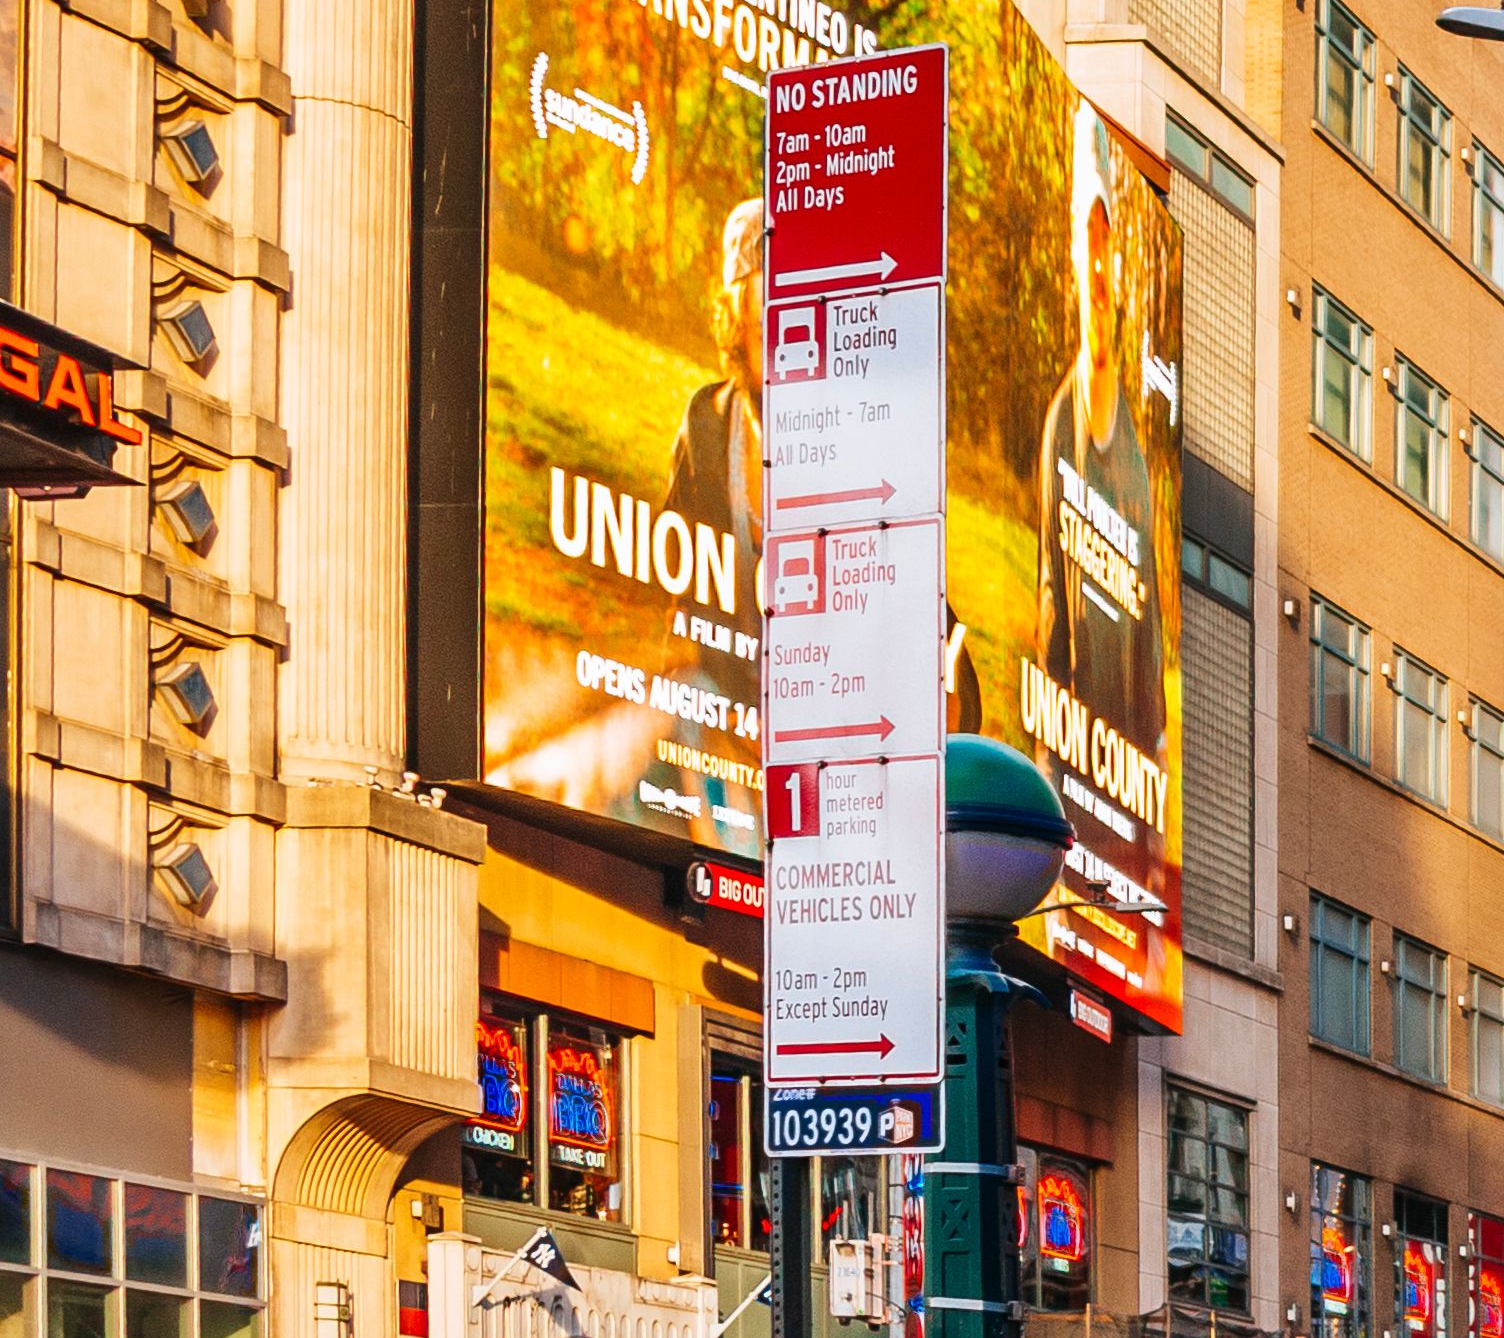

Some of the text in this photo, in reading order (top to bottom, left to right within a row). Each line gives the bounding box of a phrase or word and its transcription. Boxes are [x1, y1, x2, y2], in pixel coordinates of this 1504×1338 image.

[776, 83, 806, 113] NO
[811, 65, 918, 109] STANDING
[776, 124, 866, 155] 7am 10am
[776, 145, 895, 187] 2pm Midnight
[776, 185, 845, 213] All Days
[833, 301, 878, 326] Truck
[833, 327, 897, 352] Loading
[833, 353, 869, 380] Only
[776, 401, 891, 435] Midnight 7am
[775, 442, 837, 467] All Days
[550, 465, 736, 616] UNION
[832, 535, 877, 561] Truck
[832, 562, 896, 587] Loading
[832, 588, 868, 614] Only
[690, 615, 759, 662] FILM BY
[774, 641, 831, 667] Sunday
[576, 649, 760, 741] OPENS AUGUST 14
[773, 672, 866, 700] 10am 2pm
[1020, 655, 1089, 777] UNION
[1091, 717, 1168, 835] COUNTY
[785, 771, 801, 832] 1
[826, 771, 857, 790] hour
[826, 791, 884, 813] metered
[826, 815, 877, 840] parking
[776, 859, 896, 891] COMMERCIAL
[718, 876, 742, 903] BIG
[776, 892, 917, 925] VEHICLES ONLY
[776, 967, 867, 993] 10am 2pm
[776, 995, 889, 1023] Except Sunday
[773, 1107, 872, 1147] 103939
